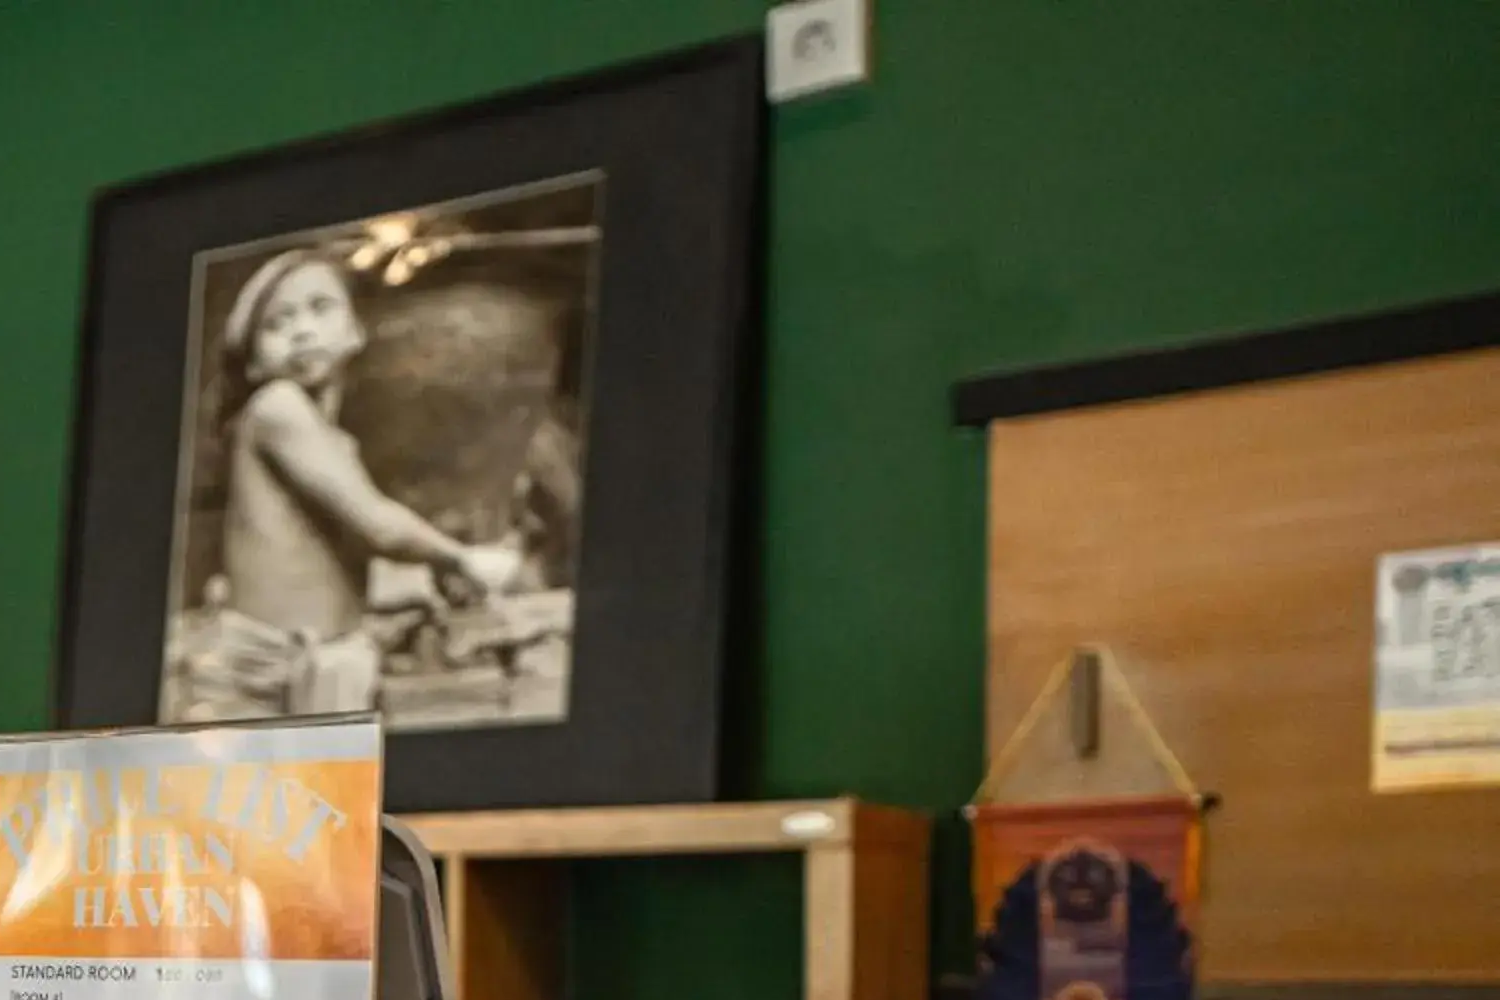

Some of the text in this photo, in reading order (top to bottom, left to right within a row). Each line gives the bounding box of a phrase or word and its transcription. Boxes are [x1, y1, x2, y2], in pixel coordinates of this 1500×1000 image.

[77, 832, 235, 875] URBAN
[74, 887, 233, 928] HAVEN
[11, 965, 85, 981] STANDARD
[87, 966, 136, 982] ROOM
